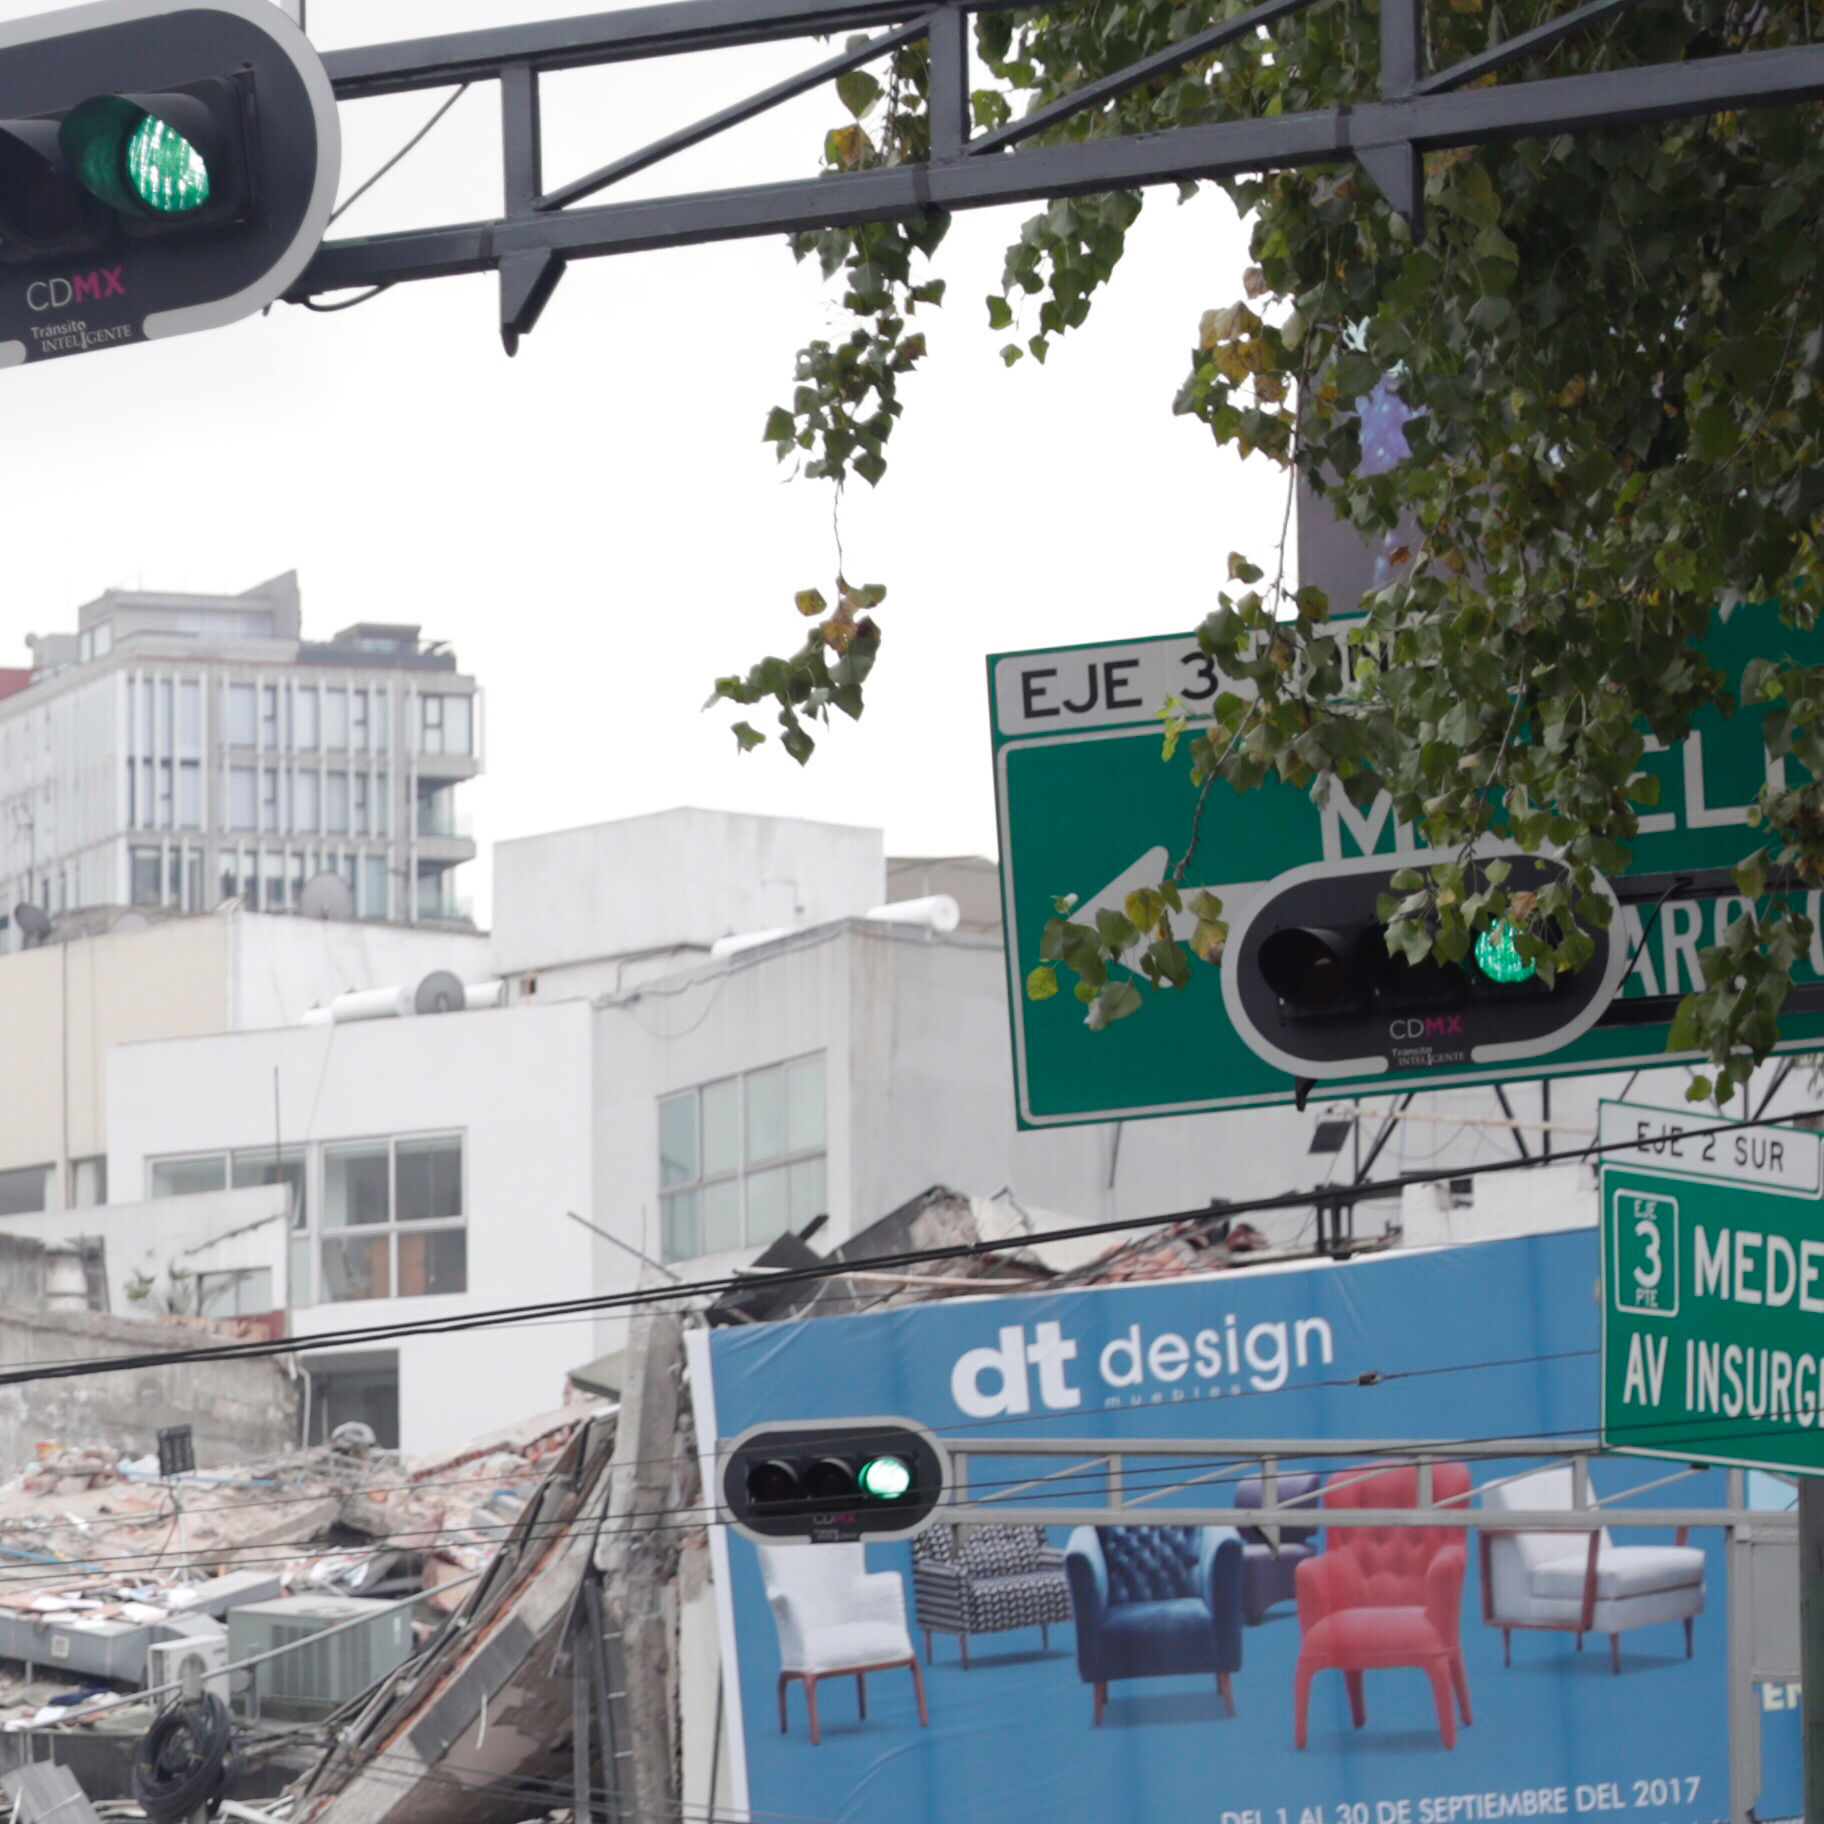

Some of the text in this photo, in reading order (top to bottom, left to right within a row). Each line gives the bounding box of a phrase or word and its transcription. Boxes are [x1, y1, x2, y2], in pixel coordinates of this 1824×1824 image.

[27, 266, 126, 311] CDMX
[31, 320, 87, 339] Tránsito
[42, 325, 132, 352] INTELIGENTE
[1021, 658, 1143, 719] EJE
[1180, 651, 1219, 701] 3
[1389, 1015, 1463, 1040] CDMX
[1637, 1121, 1784, 1173] EJE 2 SUR
[1634, 1199, 1658, 1220] EJE
[1633, 1219, 1662, 1288] 3
[1635, 1288, 1658, 1309] PTE
[951, 1313, 1333, 1418] dt design
[1622, 1331, 1824, 1429] AV INSURG
[1418, 1786, 1568, 1824] SEPTIEMBRE
[1575, 1782, 1626, 1813] DEL
[1632, 1775, 1702, 1808] 2017
